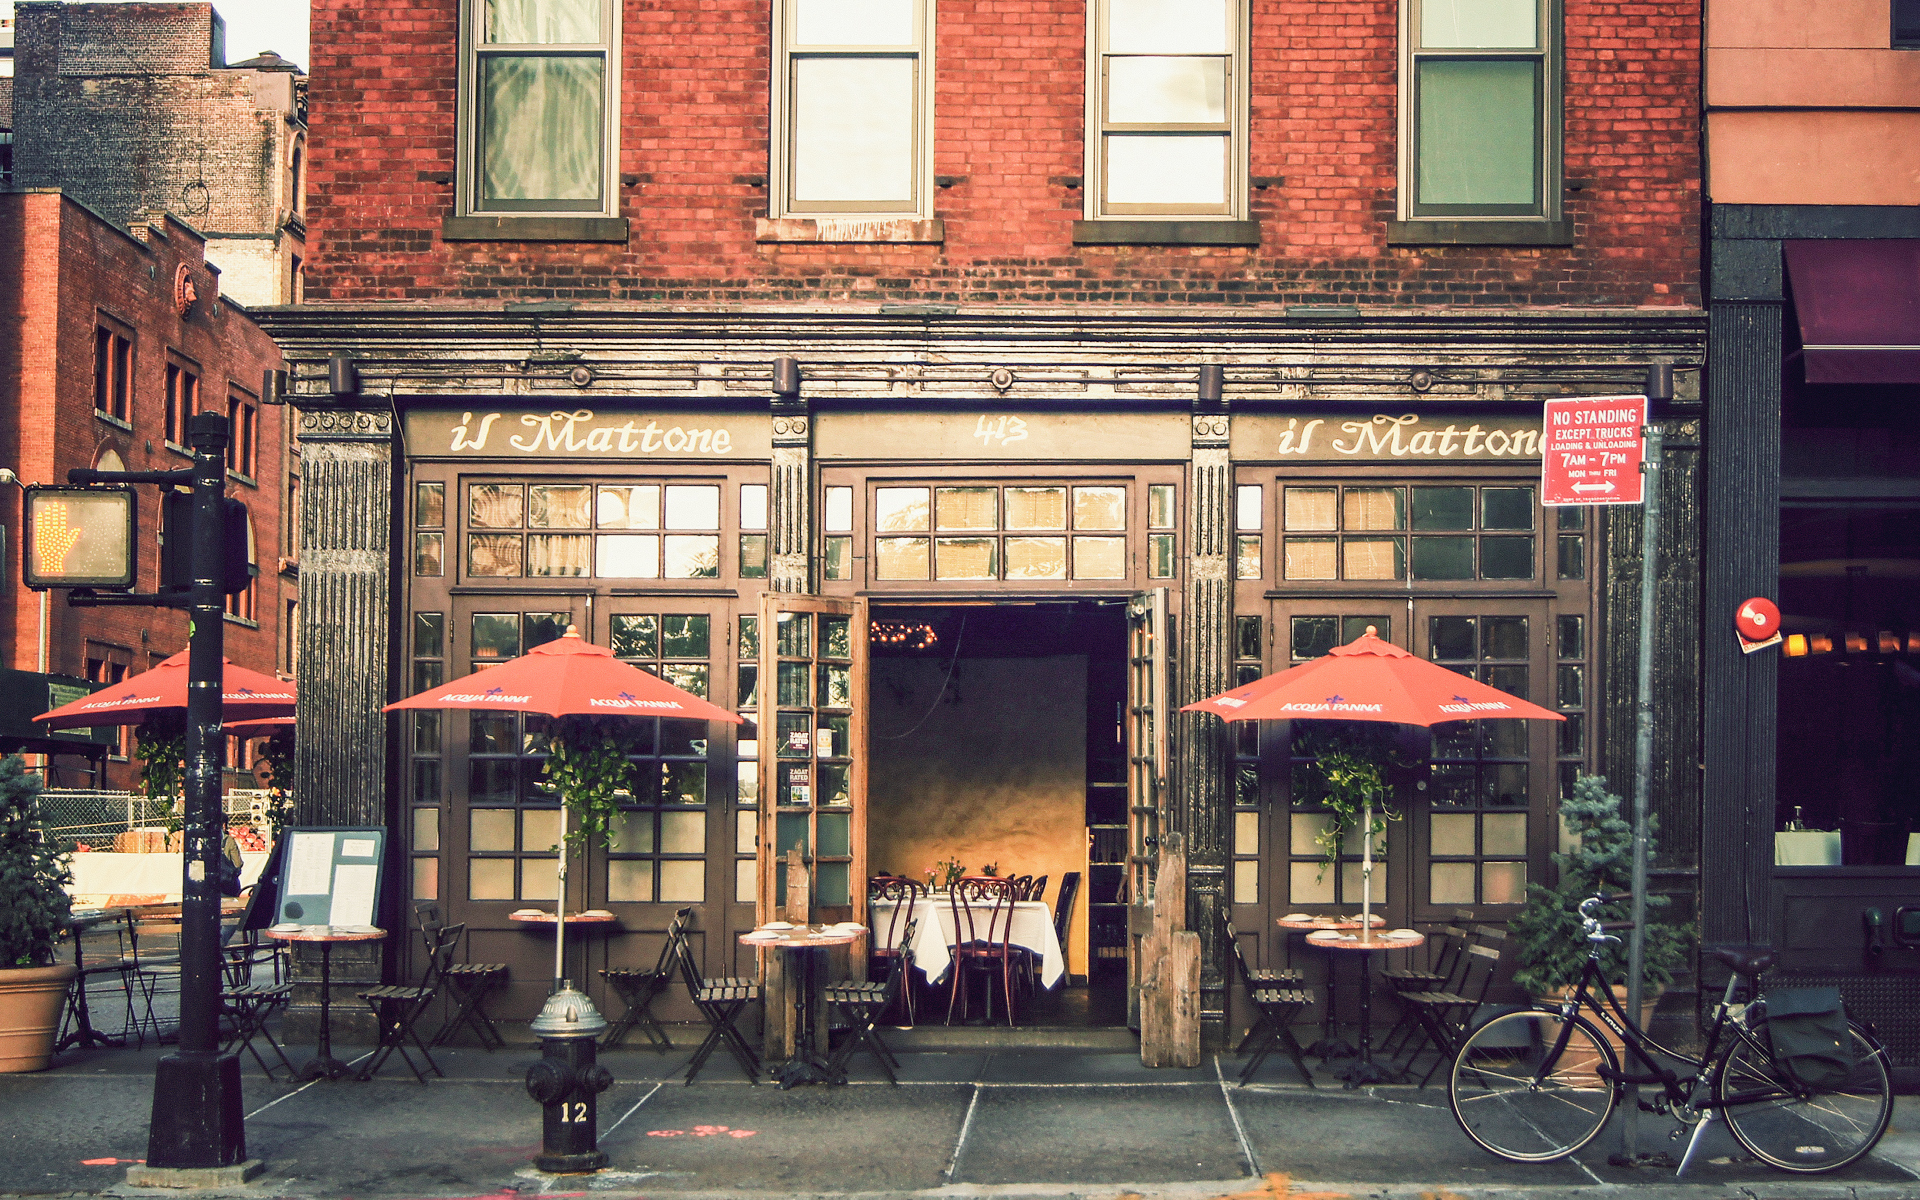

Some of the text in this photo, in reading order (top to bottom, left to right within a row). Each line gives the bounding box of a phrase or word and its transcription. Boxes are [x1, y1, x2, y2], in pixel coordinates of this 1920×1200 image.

[1553, 409, 1636, 425] NO STANDING
[510, 409, 733, 454] Mattone
[973, 415, 1029, 446] 413
[1555, 427, 1633, 440] EXCEPT TRUCKS
[1551, 440, 1637, 451] LOADING & UNLOADING
[1561, 453, 1586, 468] 7AM
[1600, 452, 1626, 467] 7PM
[1568, 470, 1586, 478] MON
[1604, 469, 1617, 477] FRI
[81, 696, 161, 709] ACQUA PANNA
[439, 693, 530, 703] ACQUA PANNA
[590, 698, 683, 709] ACQUA PANNA
[1280, 702, 1382, 712] ACQUA PANNA
[1438, 703, 1476, 713] ACQUA
[561, 1102, 587, 1122] 12
